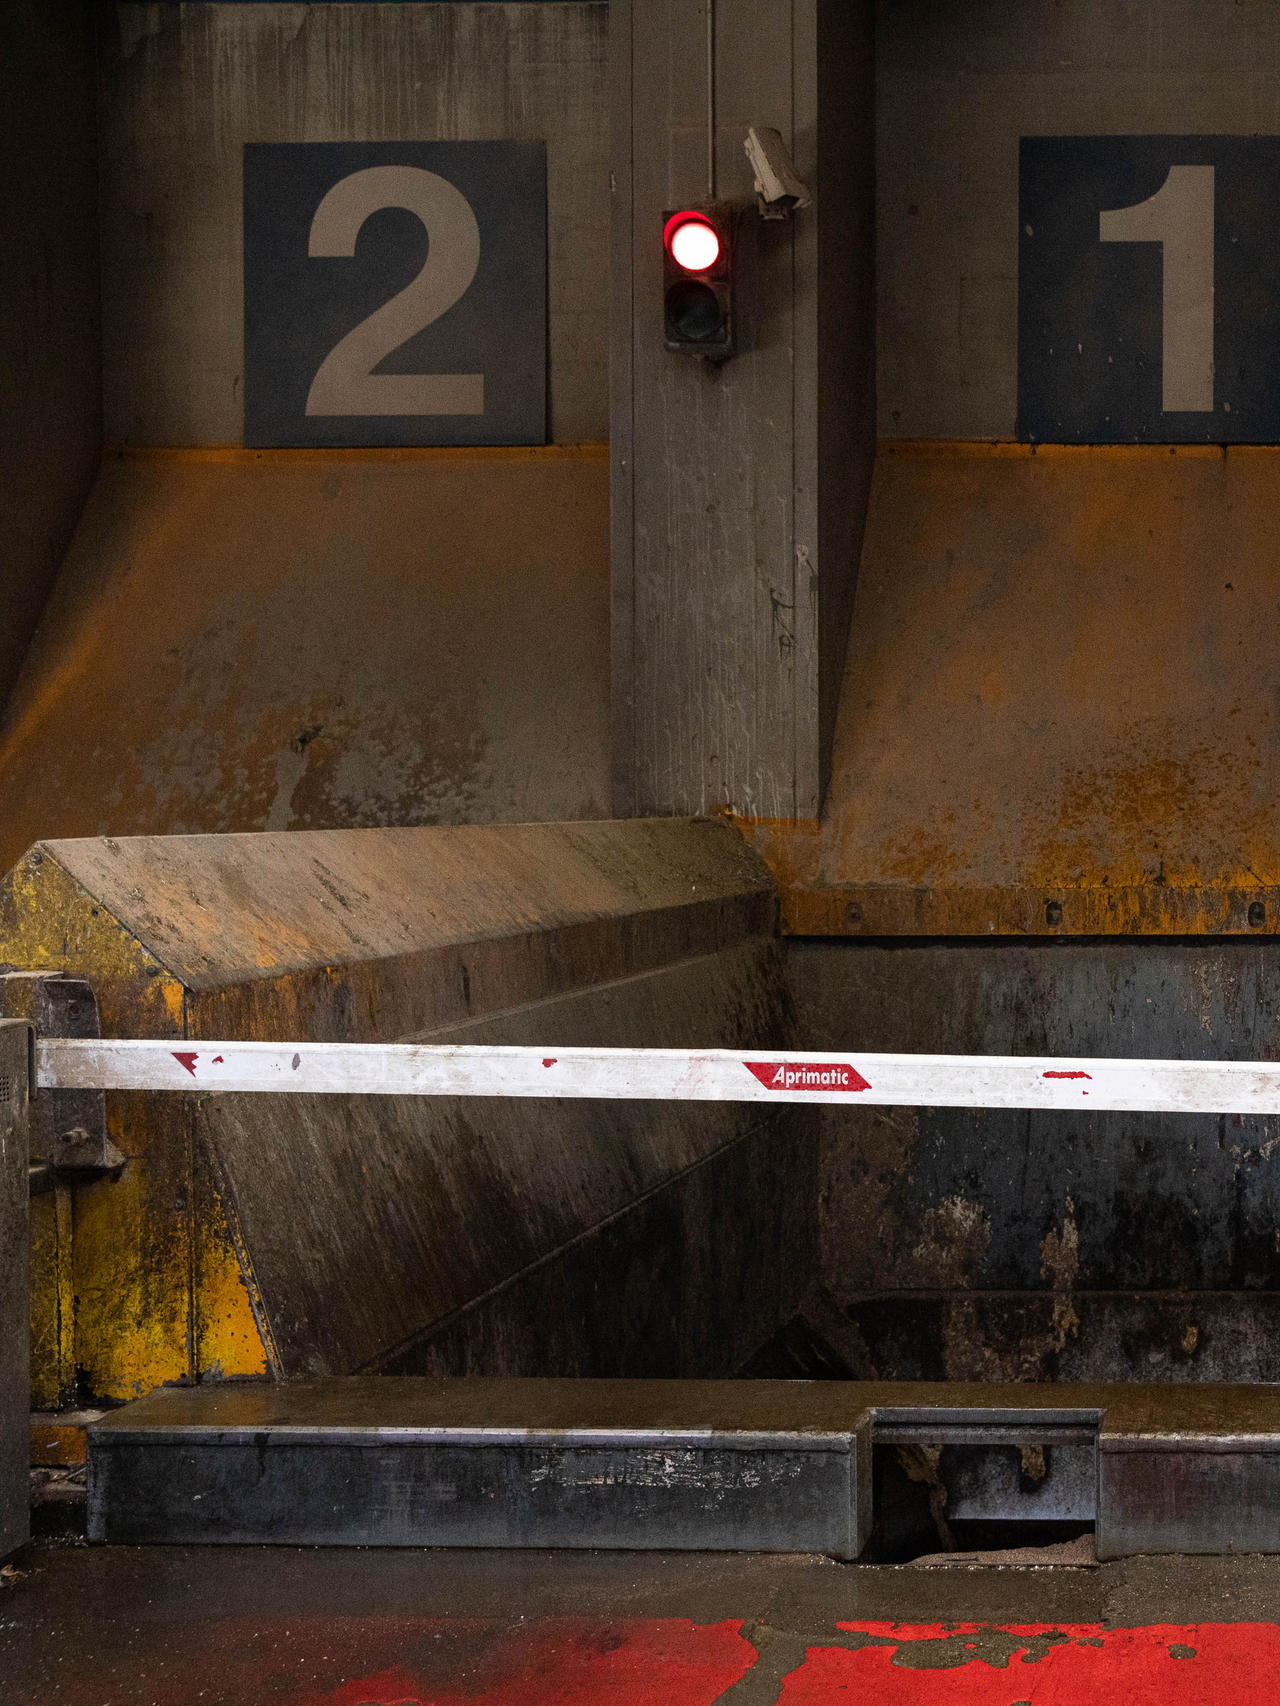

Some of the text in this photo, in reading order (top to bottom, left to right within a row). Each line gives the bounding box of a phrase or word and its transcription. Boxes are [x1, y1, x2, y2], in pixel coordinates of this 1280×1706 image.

[305, 165, 485, 416] 2
[1099, 165, 1215, 412] 1
[771, 1066, 849, 1088] Aprimatic
